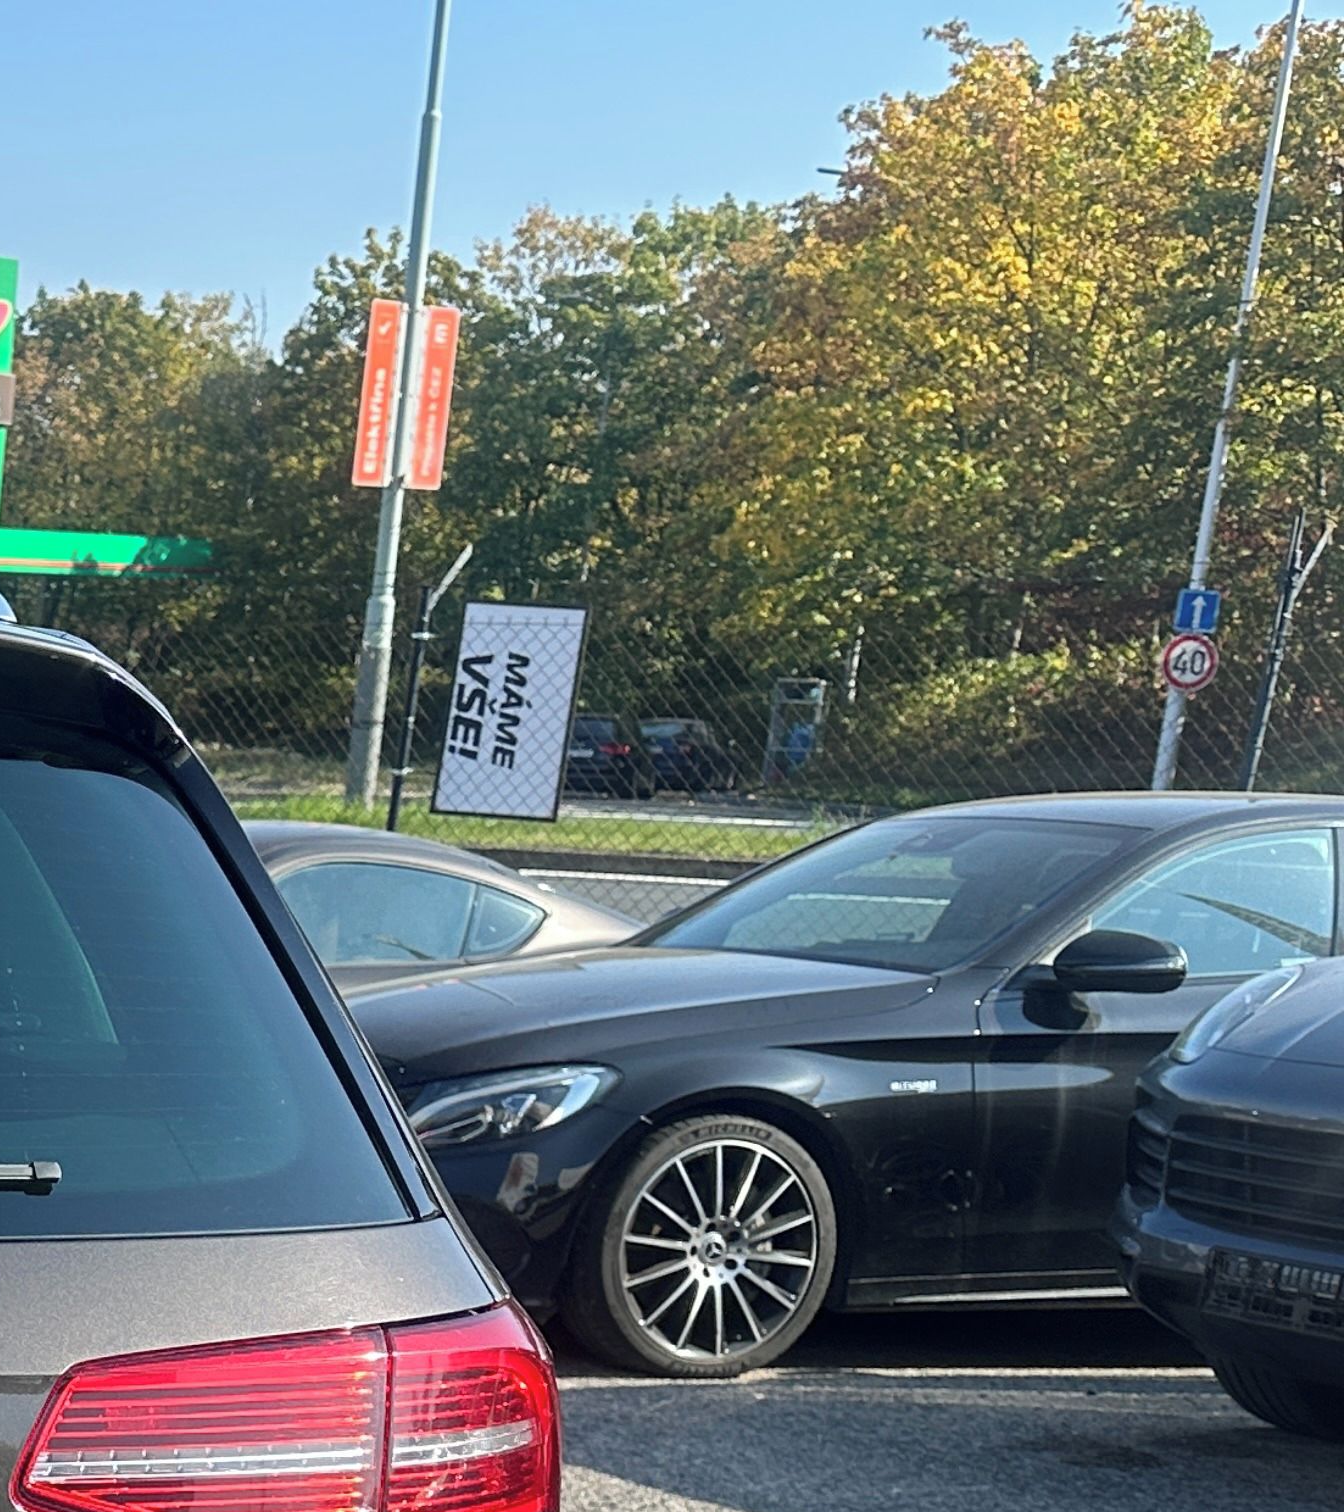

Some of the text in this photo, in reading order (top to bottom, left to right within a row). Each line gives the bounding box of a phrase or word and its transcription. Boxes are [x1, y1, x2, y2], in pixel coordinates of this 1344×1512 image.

[448, 655, 497, 761] VŠE!
[492, 652, 532, 770] MÁME
[1173, 649, 1206, 676] 40
